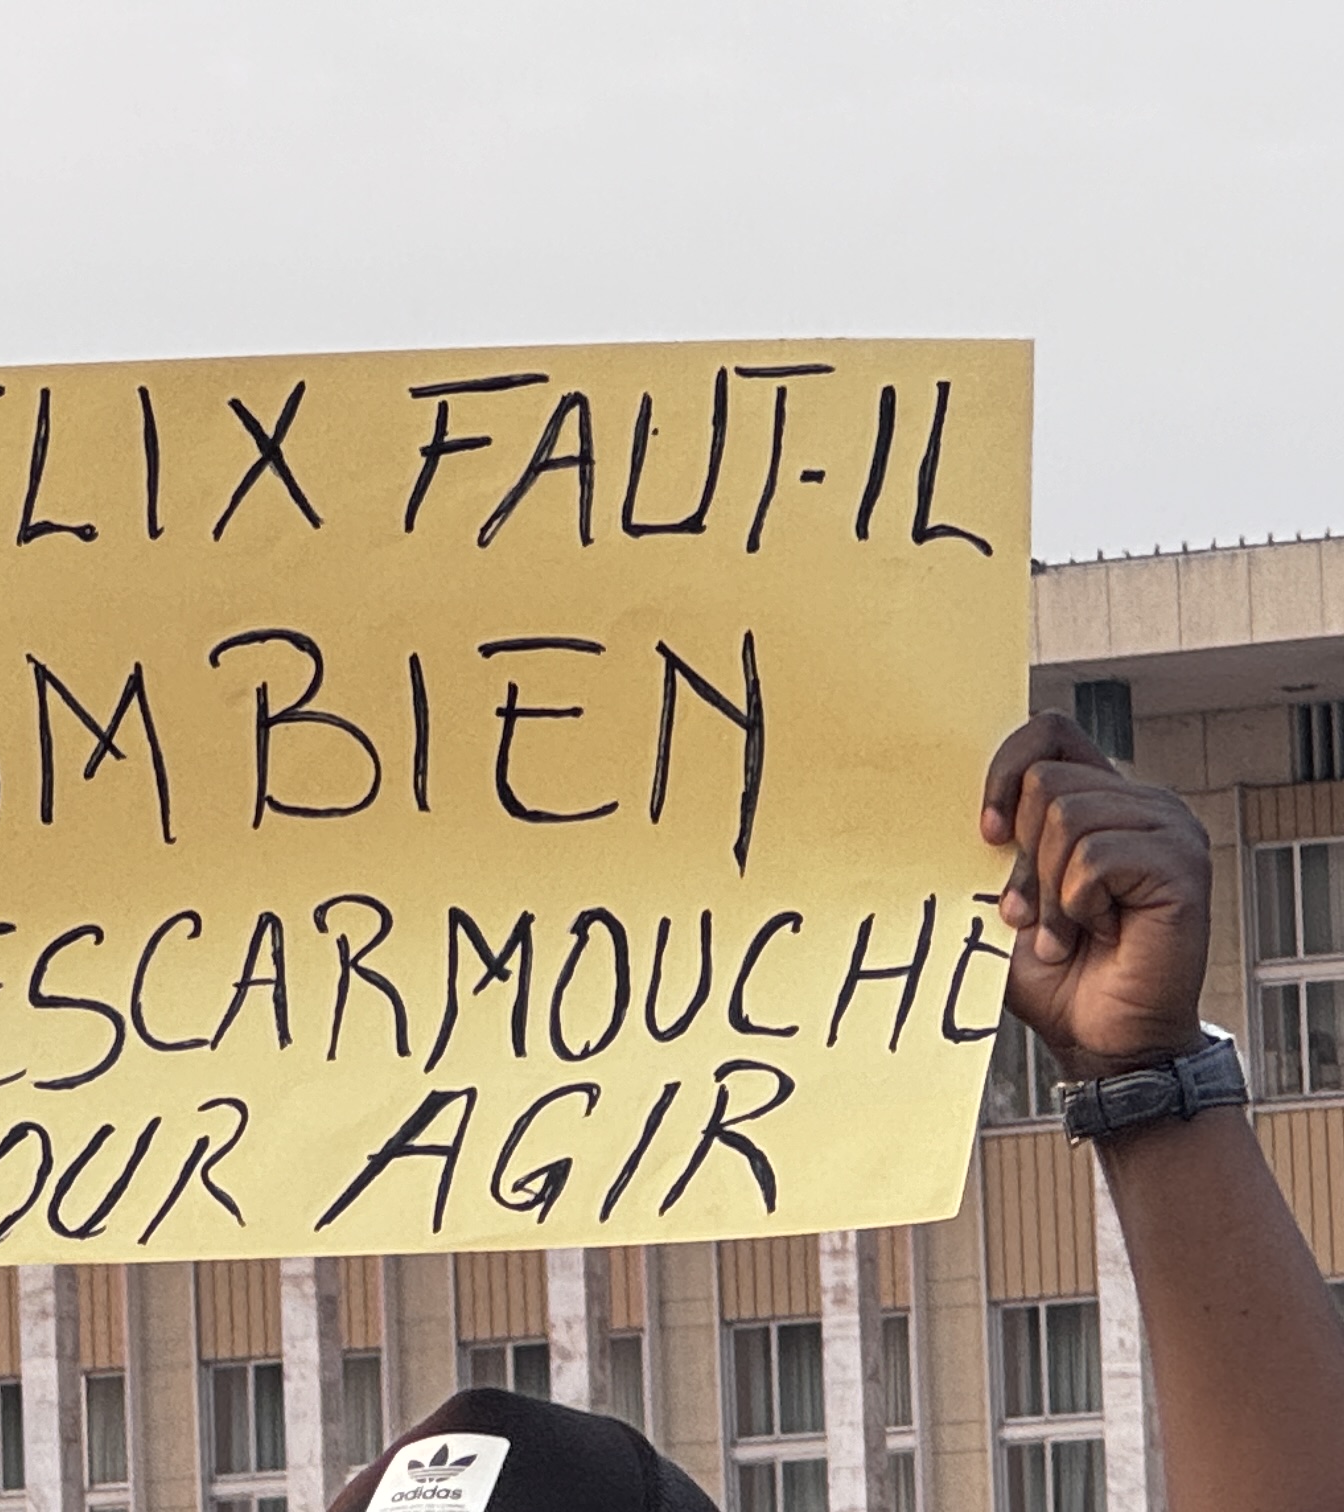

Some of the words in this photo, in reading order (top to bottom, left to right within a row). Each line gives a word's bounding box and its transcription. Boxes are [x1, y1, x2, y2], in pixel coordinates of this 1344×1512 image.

[403, 364, 994, 558] FAUT-IL
[313, 1058, 796, 1235] AGIR
[391, 1484, 463, 1503] adidas
